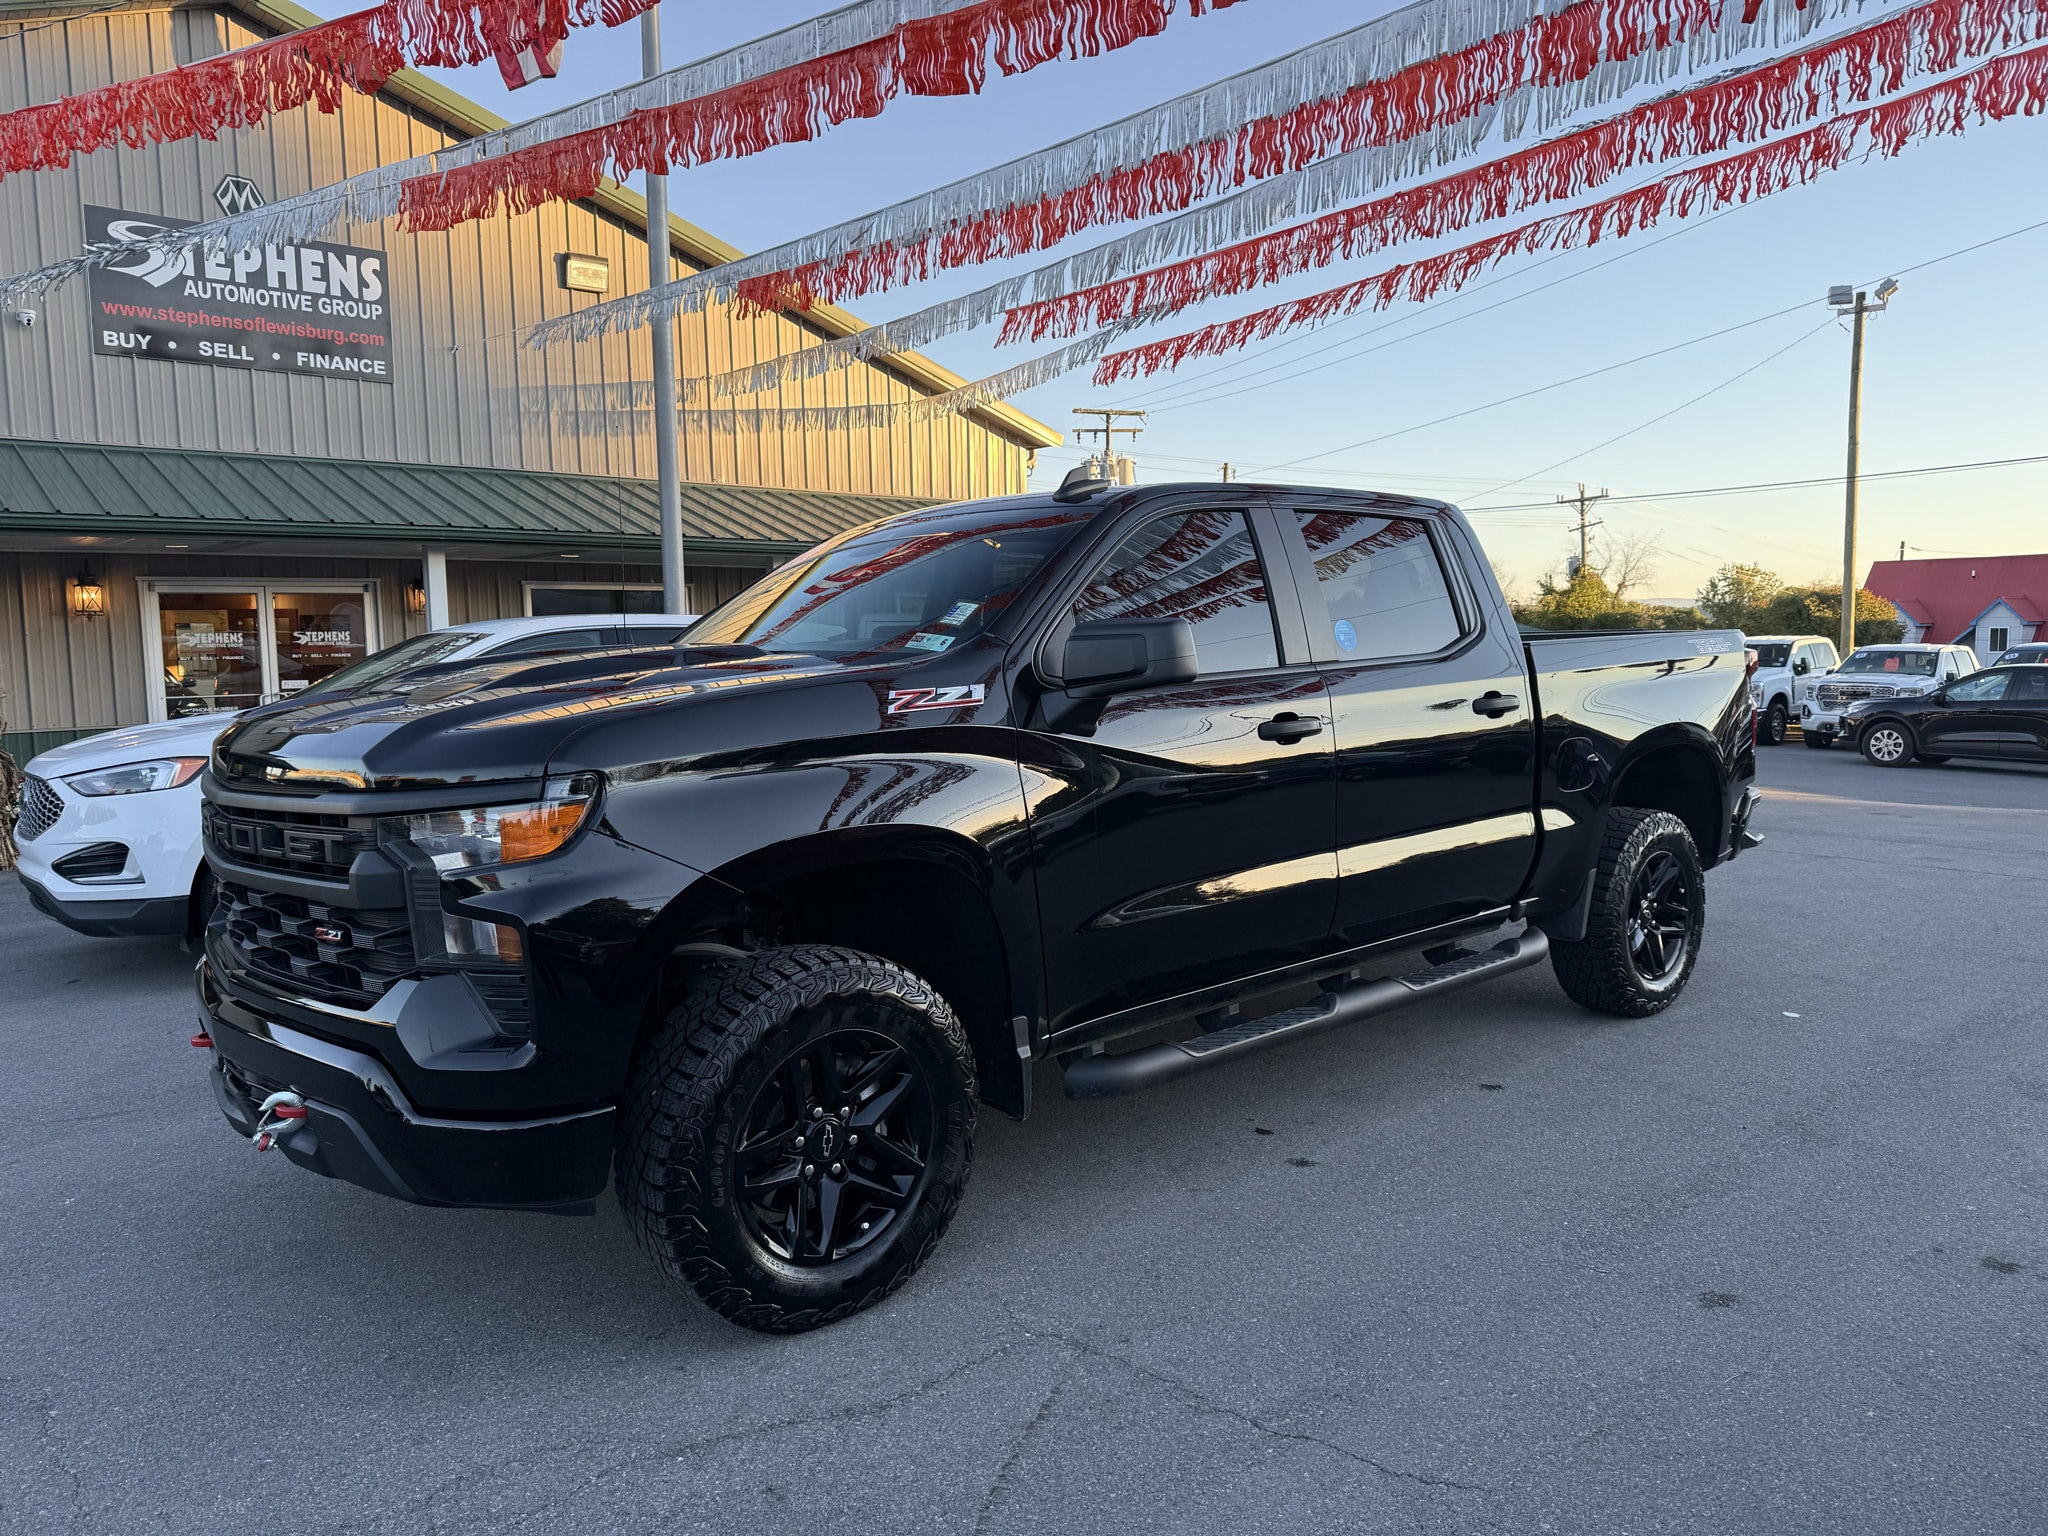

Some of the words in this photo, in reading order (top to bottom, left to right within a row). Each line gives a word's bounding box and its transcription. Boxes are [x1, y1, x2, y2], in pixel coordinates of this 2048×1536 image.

[183, 279, 313, 312] AUTOMOTIVE
[317, 298, 383, 320] GROUP
[101, 301, 385, 346] www.stephensoflewisburg.com
[102, 330, 152, 350] BUY
[198, 340, 255, 361] SELL
[296, 351, 386, 375] FINANCE
[179, 632, 244, 647] STEPHENS
[292, 631, 351, 645] STEPHENS
[887, 683, 985, 714] Z71
[314, 927, 344, 942] Z71
